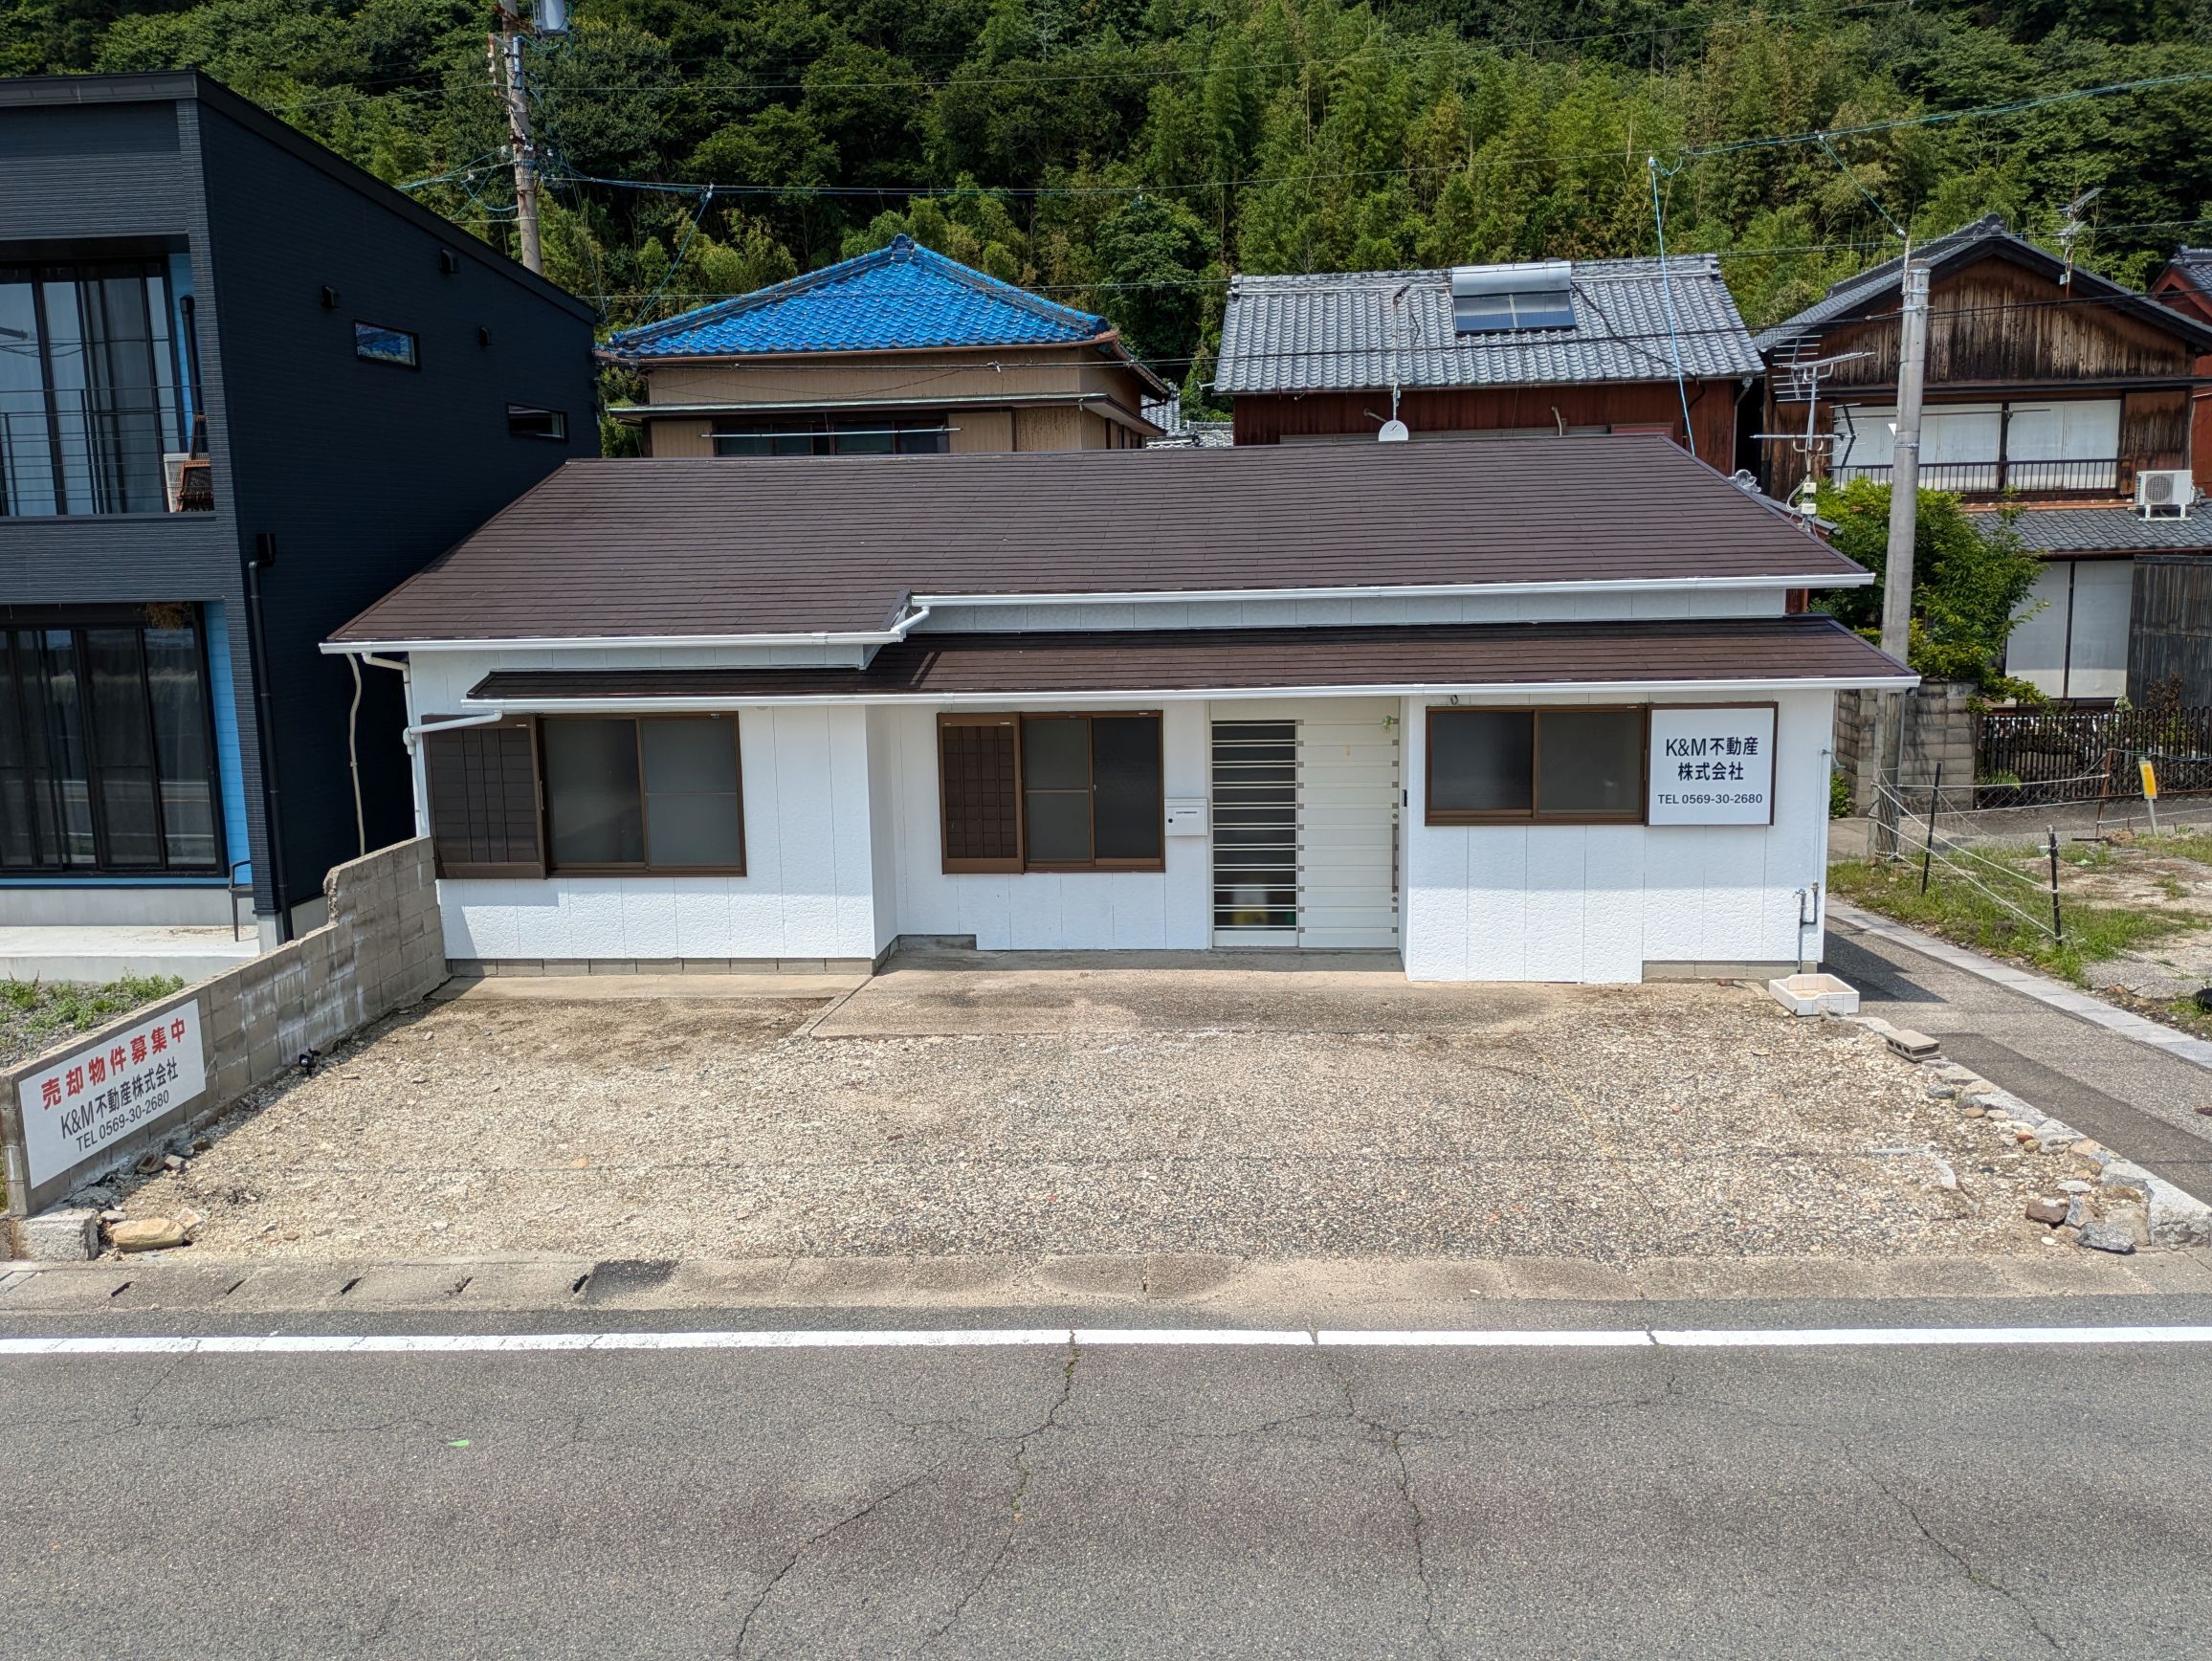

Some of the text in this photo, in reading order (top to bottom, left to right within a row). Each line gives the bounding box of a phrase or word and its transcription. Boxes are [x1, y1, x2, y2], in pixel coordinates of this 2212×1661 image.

[1666, 737, 1759, 757] K&M不動産
[1677, 762, 1744, 781] 株式会社
[1658, 793, 1763, 805] TEL 0569-30-2680
[41, 1018, 186, 1110] 売却物件募集中
[60, 1056, 179, 1139] K&M不動産株式会社
[77, 1090, 169, 1152] TEL 0569-30-2680
